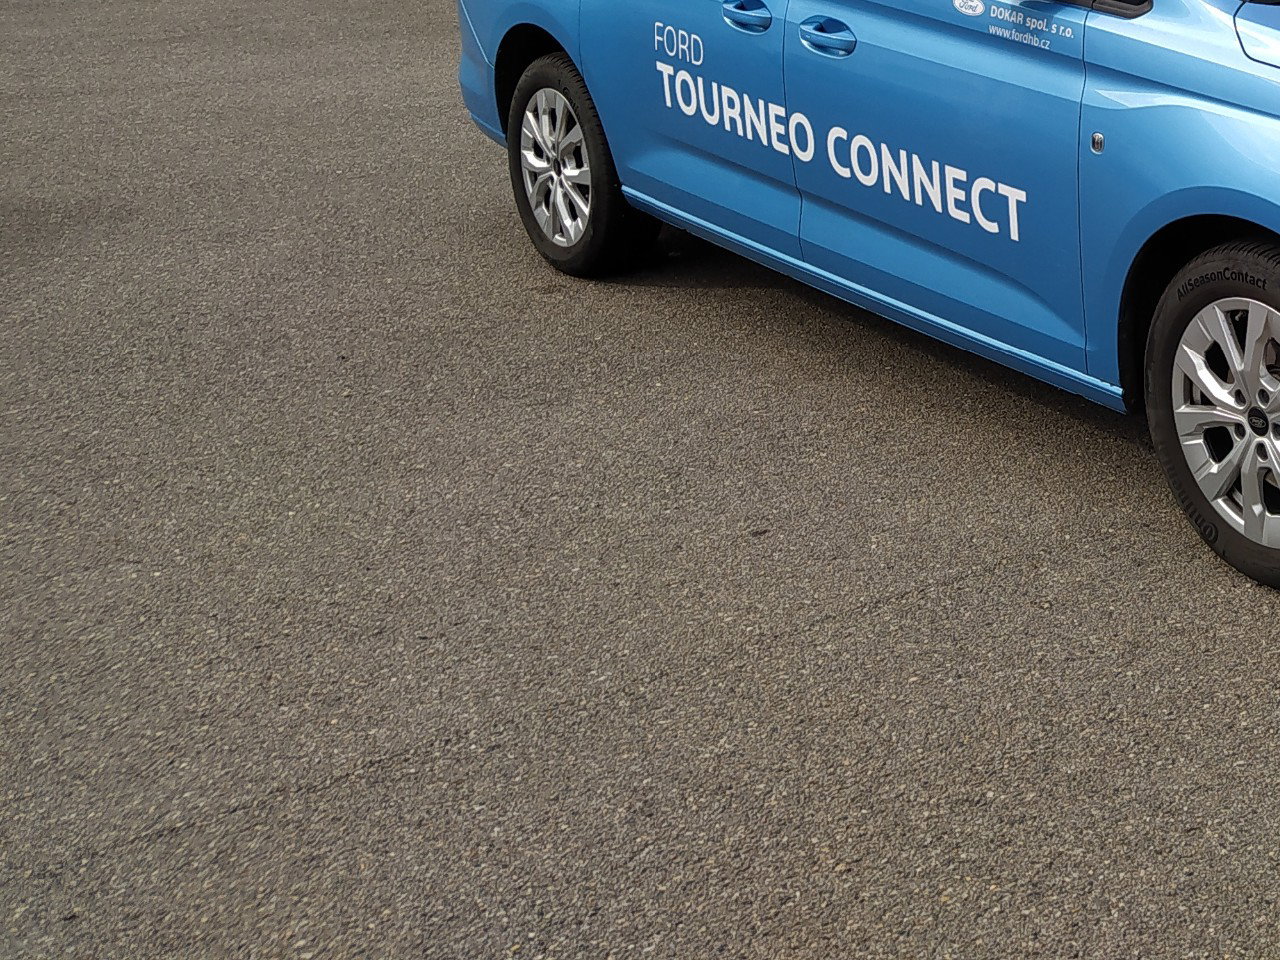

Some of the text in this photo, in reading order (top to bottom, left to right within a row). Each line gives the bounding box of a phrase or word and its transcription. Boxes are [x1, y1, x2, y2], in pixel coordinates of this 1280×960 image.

[990, 5, 1024, 25] DOKAR
[654, 21, 704, 66] FORD
[988, 25, 1051, 50] www.fordhb.cz
[655, 60, 815, 162] TOURNEO
[827, 126, 1027, 242] CONNECT
